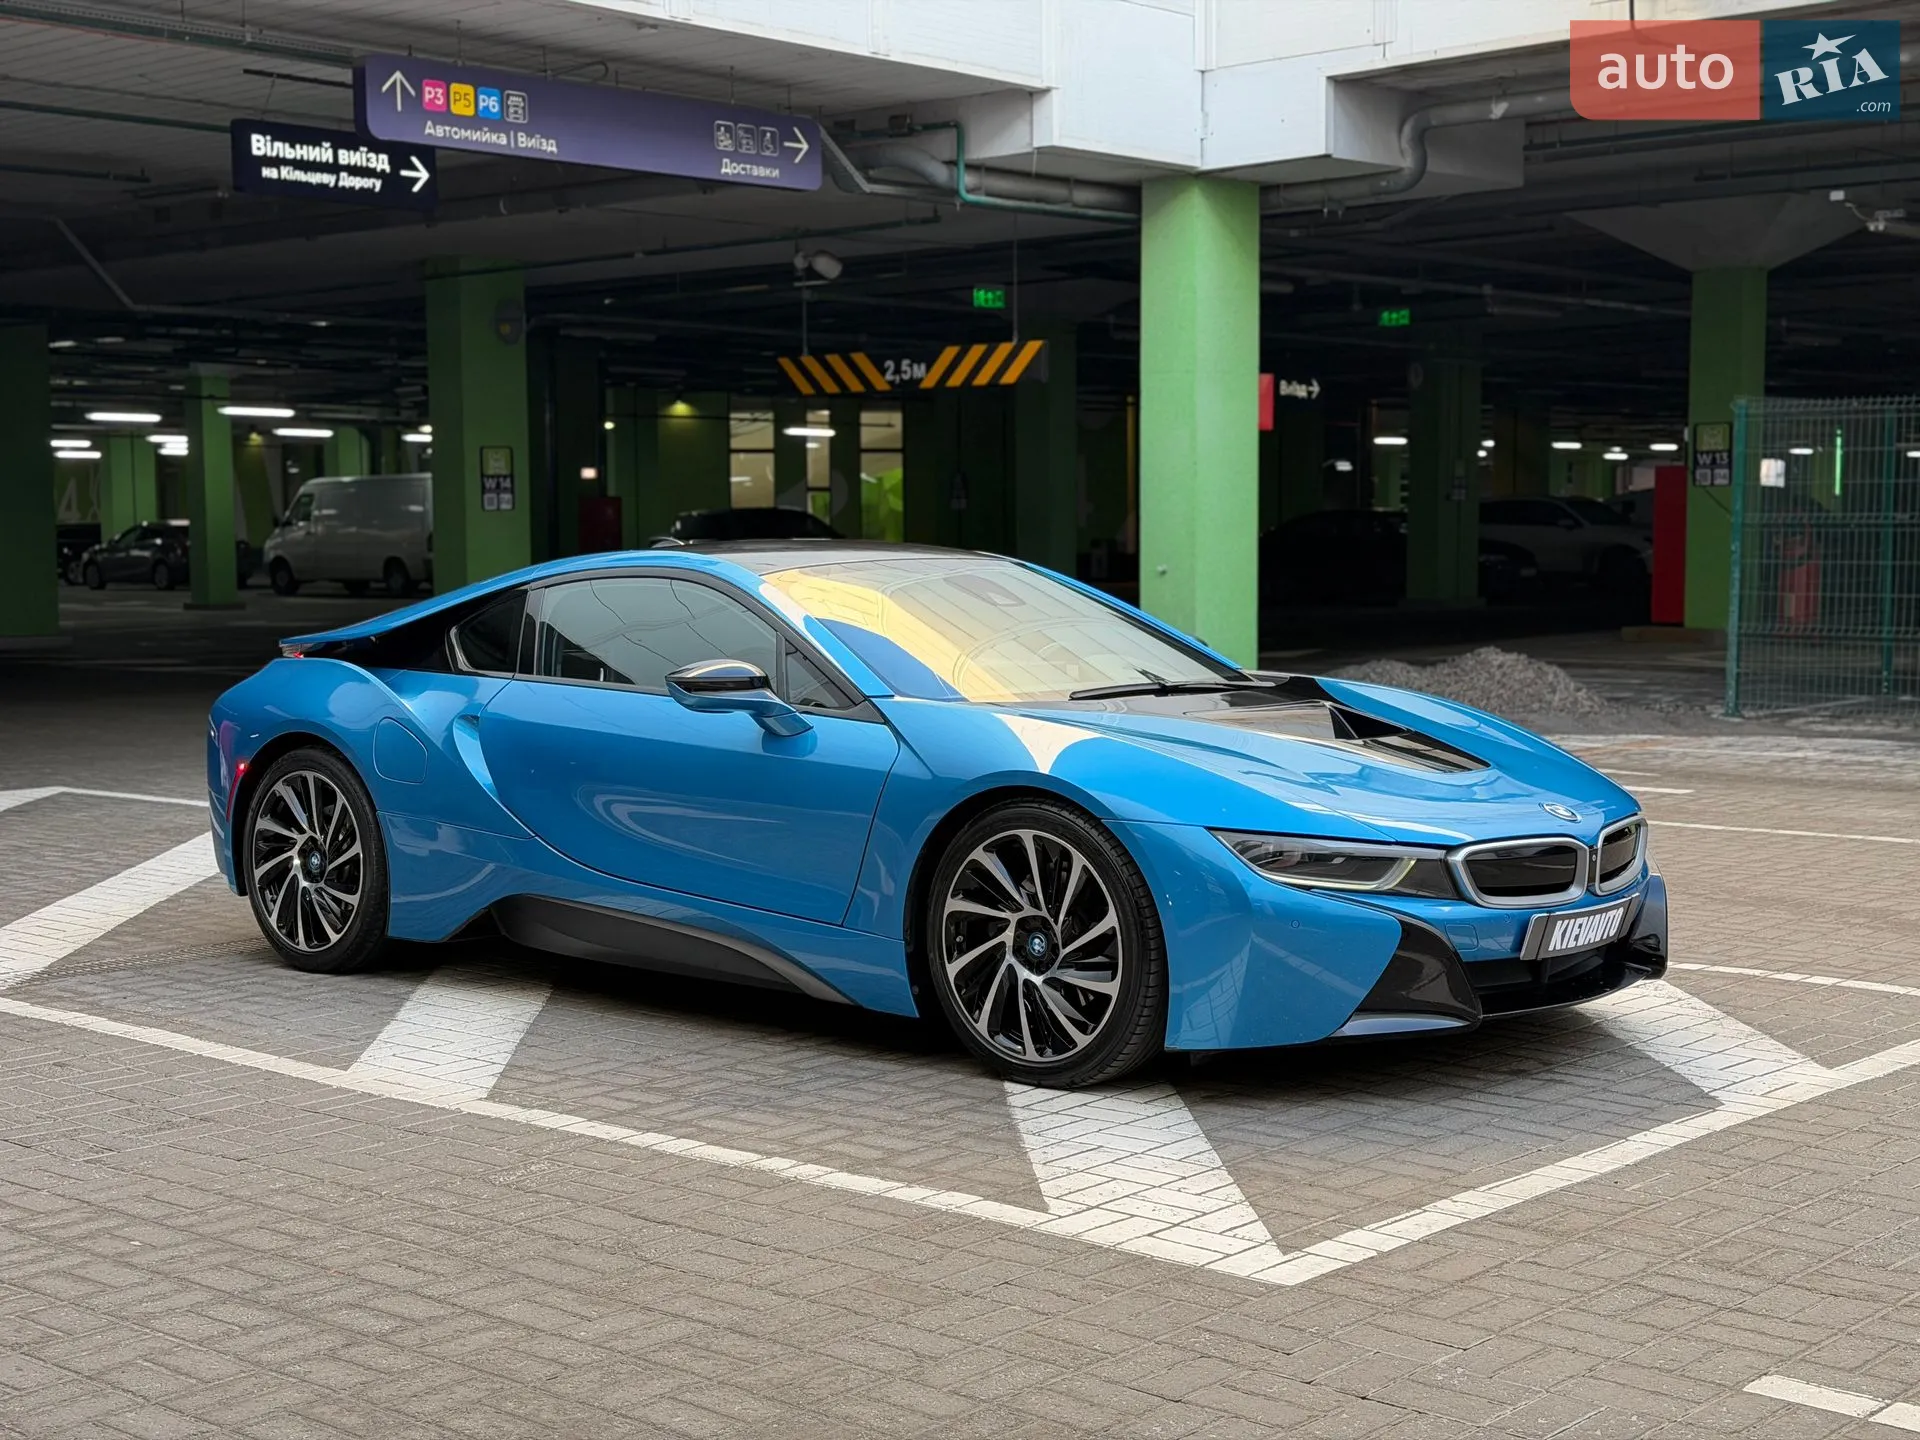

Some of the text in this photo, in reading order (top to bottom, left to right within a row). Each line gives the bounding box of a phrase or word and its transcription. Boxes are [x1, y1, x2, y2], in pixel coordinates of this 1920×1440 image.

[424, 86, 499, 113] P3 P5 P6
[424, 120, 507, 145] Автомийка
[517, 131, 558, 154] Виїзд
[250, 133, 391, 174] Вільний виїзд
[261, 164, 382, 193] на Кільцеву Дорогу
[720, 158, 780, 178] Доставки
[1696, 451, 1729, 465] W 13
[483, 476, 512, 490] W 14
[1548, 907, 1624, 951] KIEVAVTO
